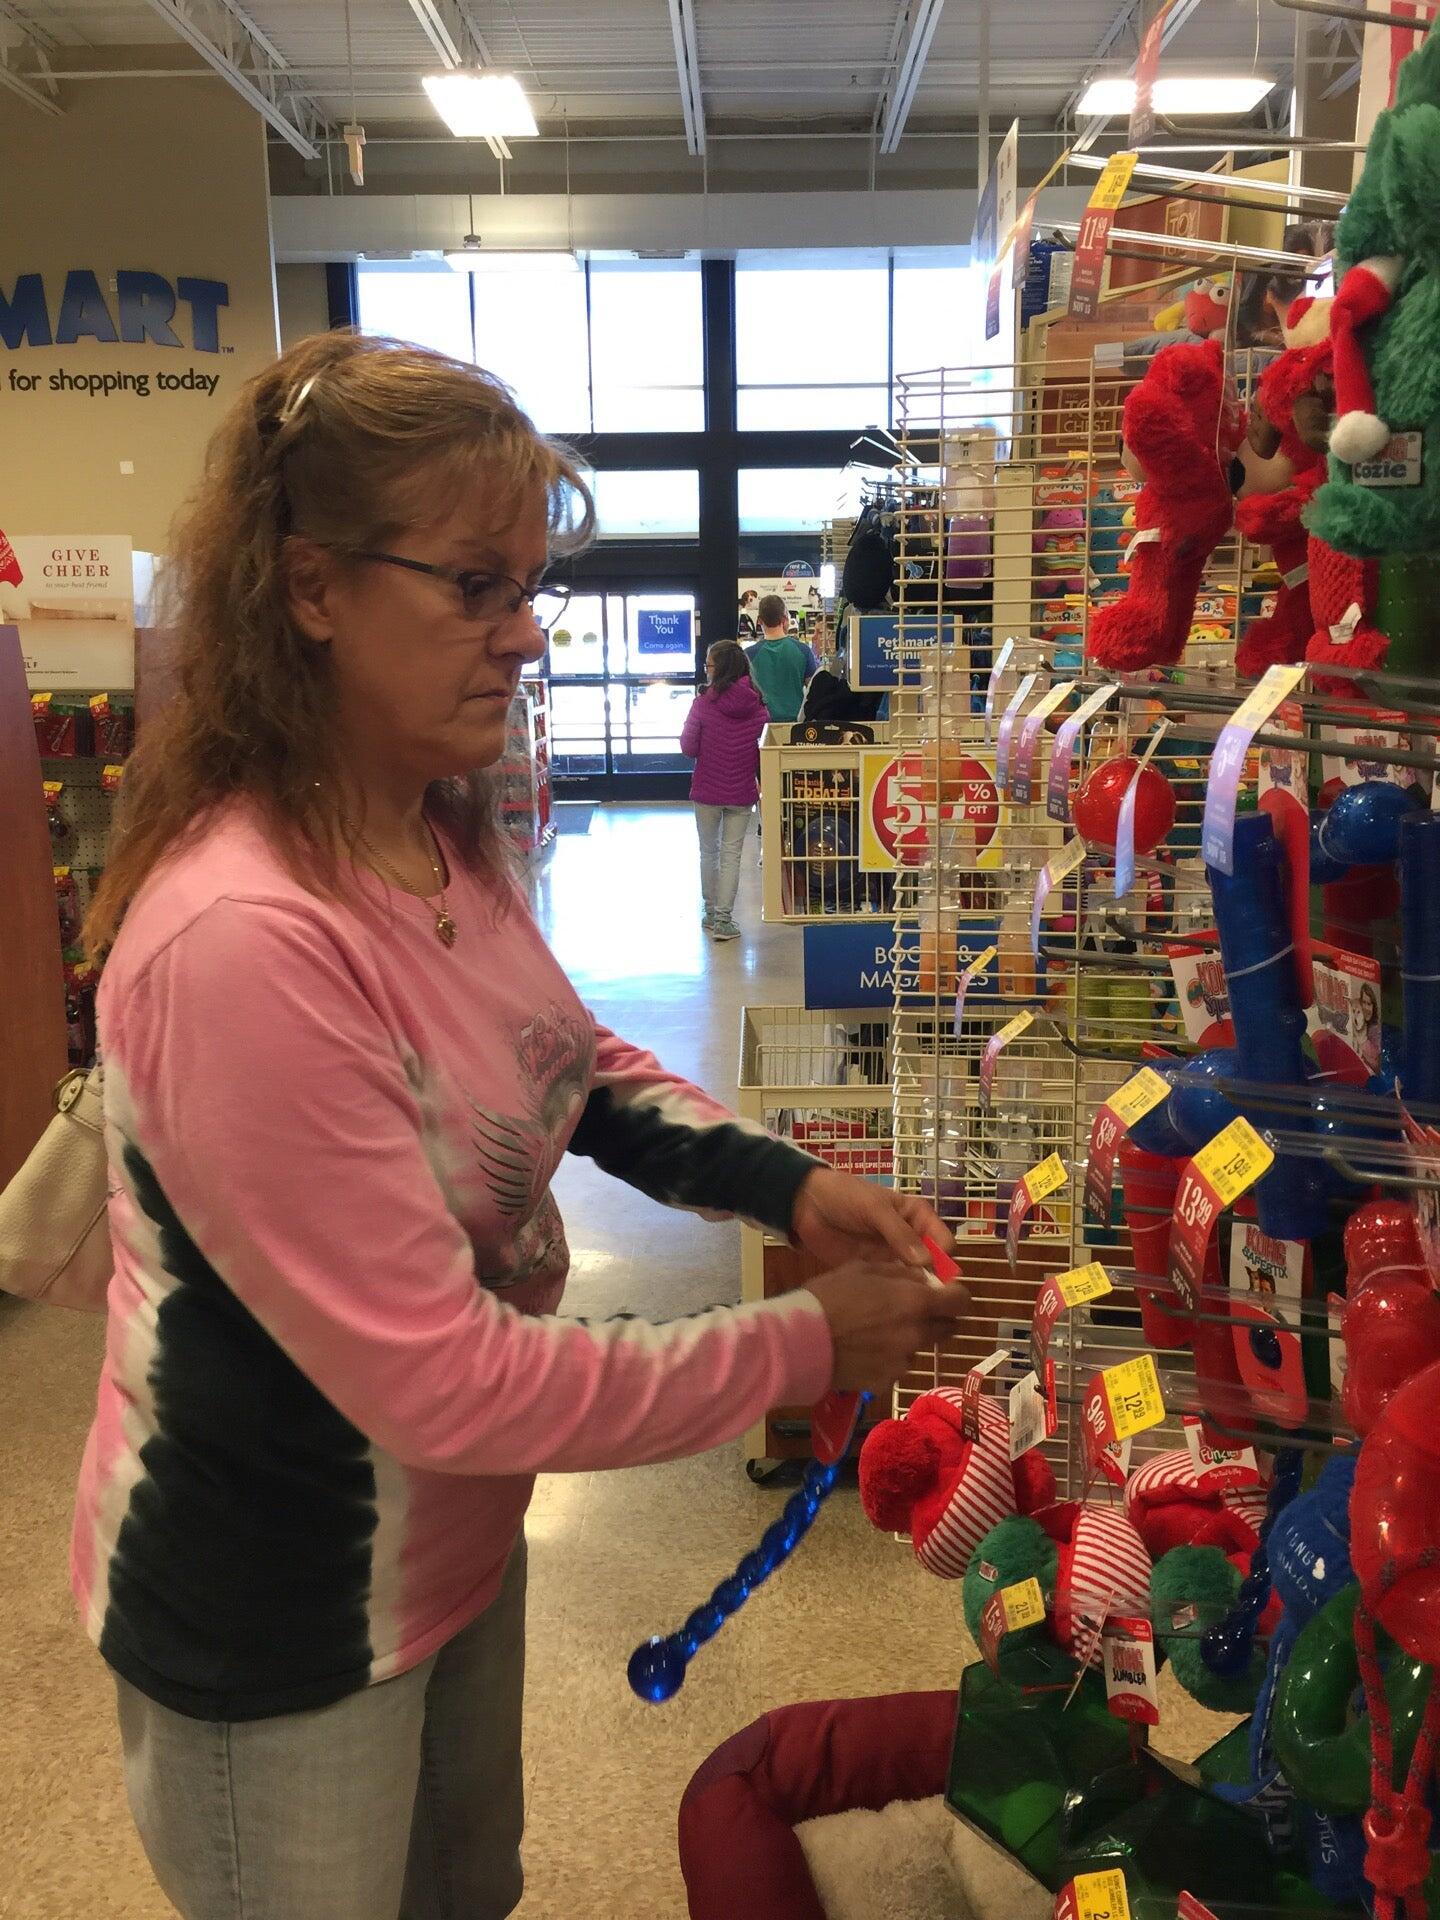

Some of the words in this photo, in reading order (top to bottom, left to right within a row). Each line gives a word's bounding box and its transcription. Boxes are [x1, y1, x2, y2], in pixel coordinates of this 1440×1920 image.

[9, 369, 42, 391] for
[49, 368, 150, 397] shopping
[157, 368, 219, 396] today
[1354, 462, 1407, 479] Cozie
[51, 549, 100, 561] GIVE
[43, 565, 110, 577] CHEER
[648, 615, 680, 625] Thank
[654, 625, 674, 634] You
[644, 642, 664, 650] Come
[877, 636, 937, 648] Petmart
[882, 649, 922, 661] Traini
[958, 945, 974, 963] &
[1178, 1177, 1213, 1230] 1399
[1123, 1391, 1147, 1420] 1299
[1087, 1394, 1107, 1436] 909
[1112, 1668, 1147, 1686] JUMBLER
